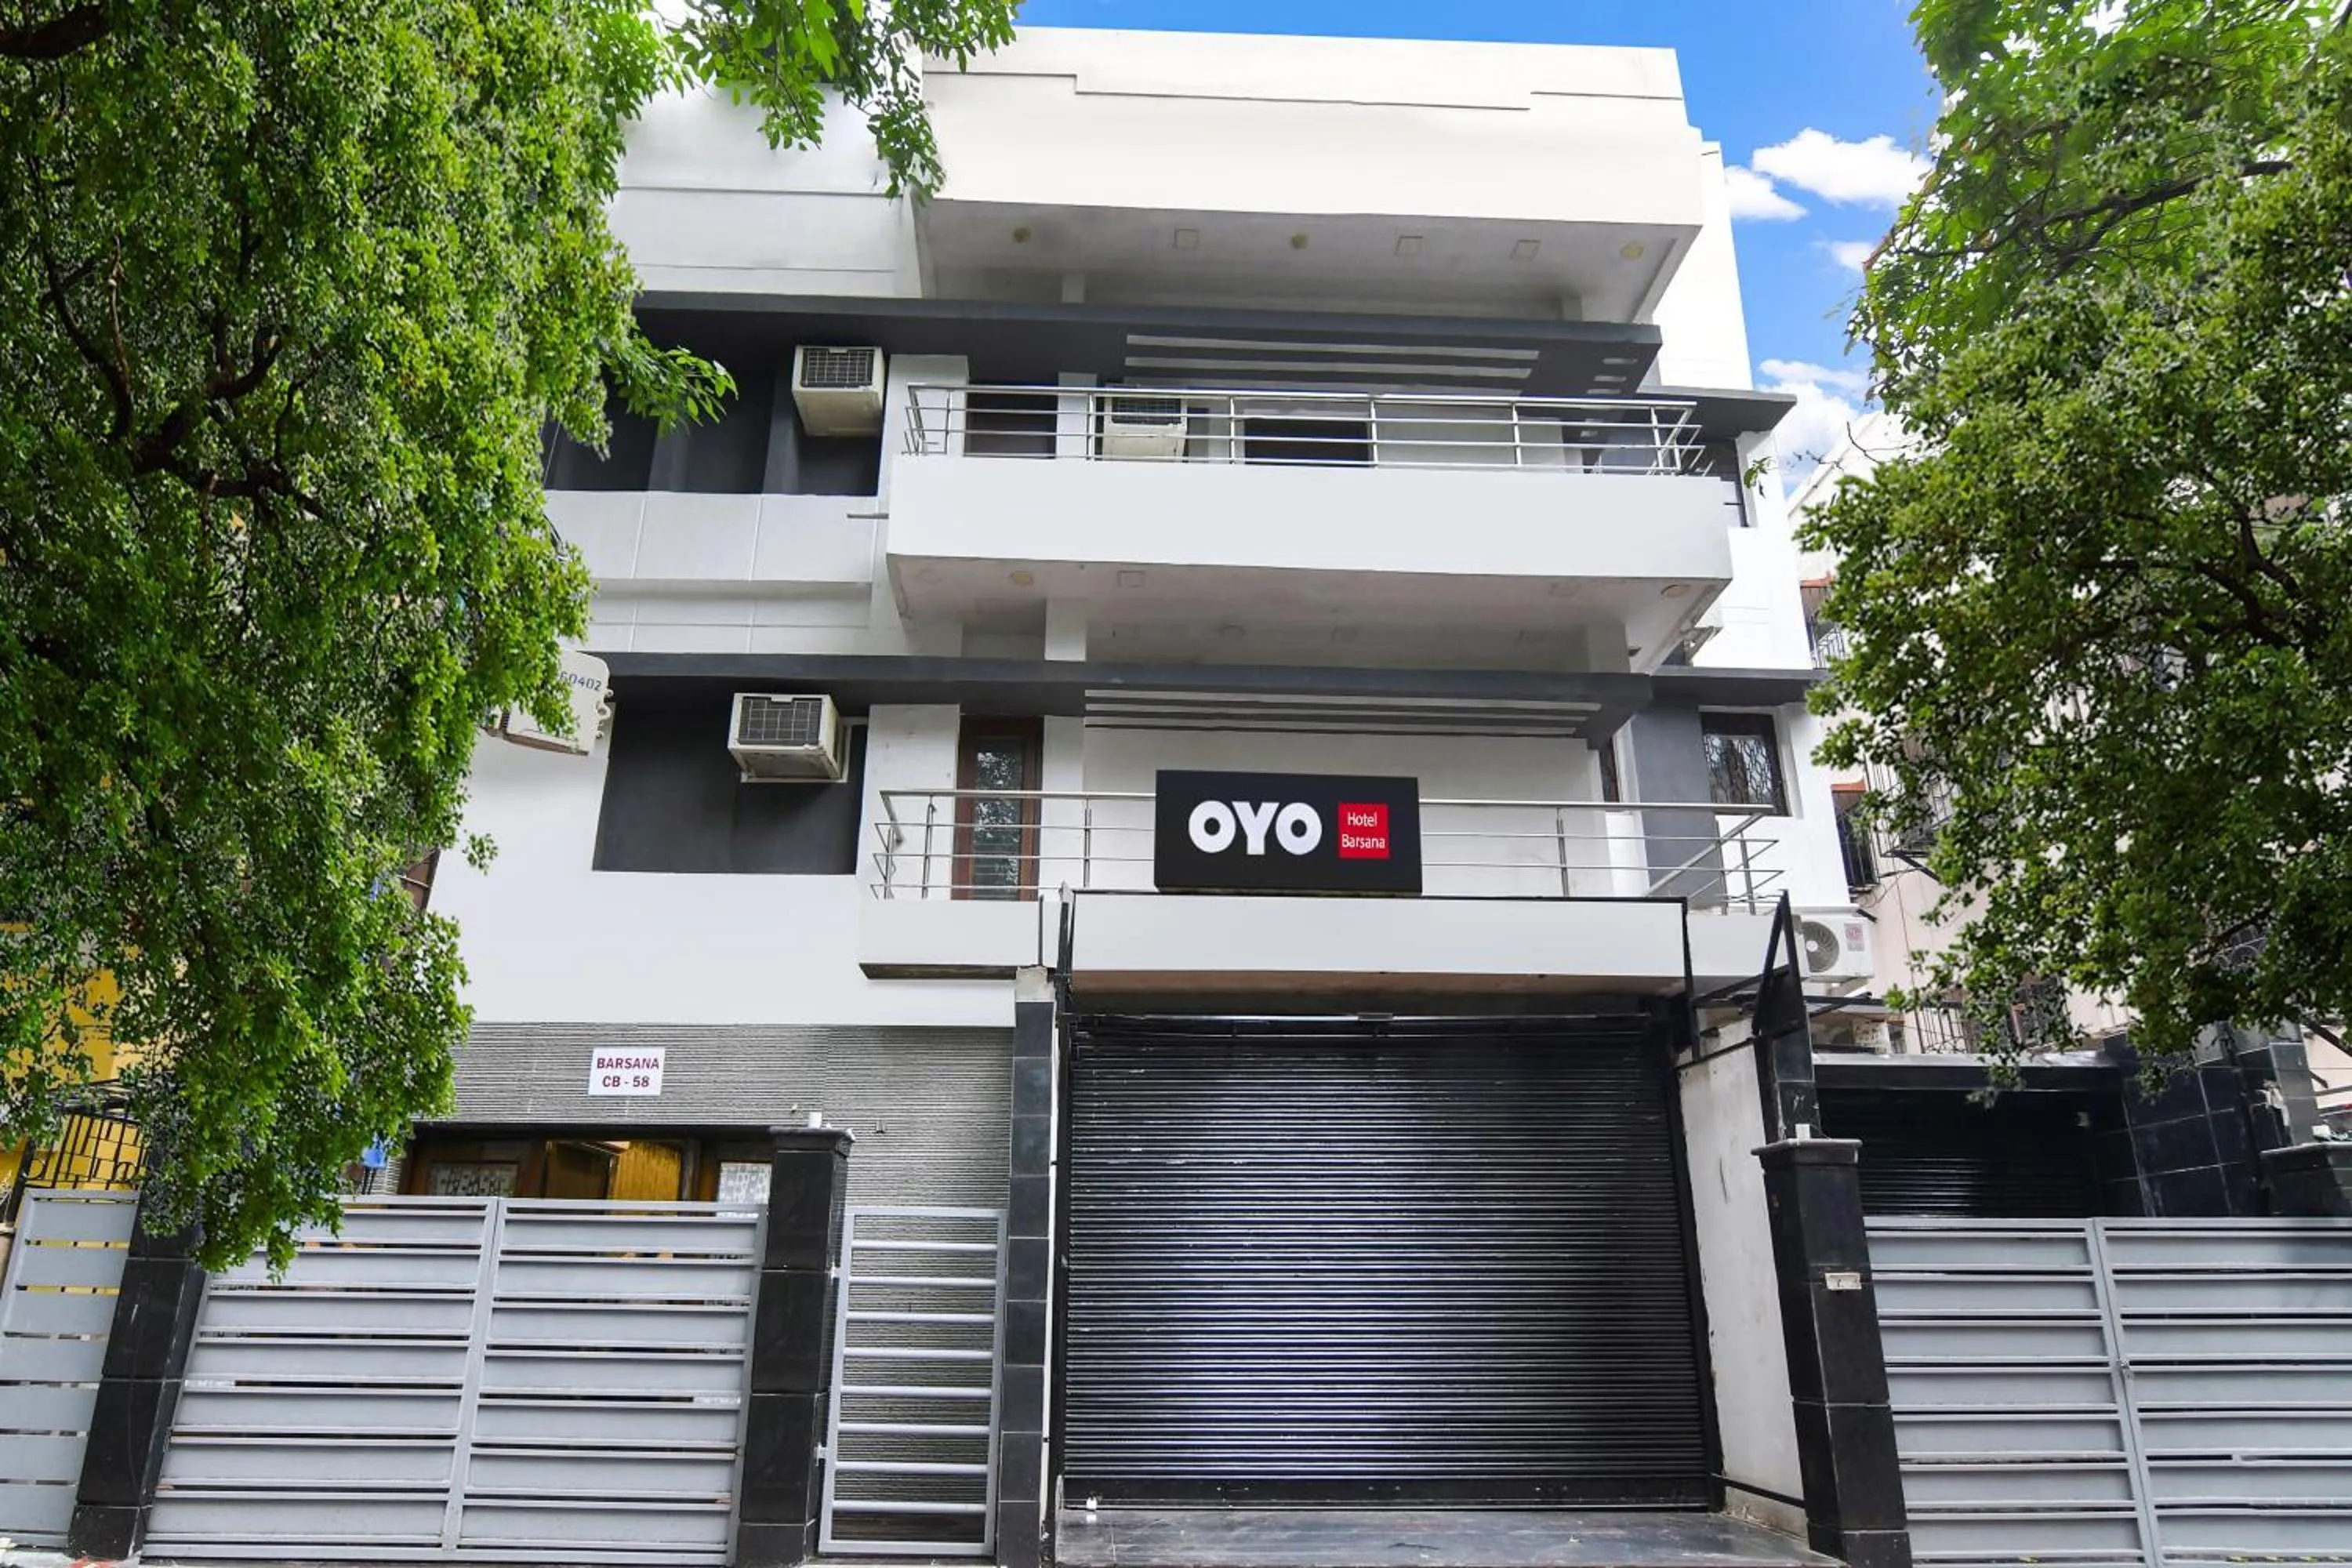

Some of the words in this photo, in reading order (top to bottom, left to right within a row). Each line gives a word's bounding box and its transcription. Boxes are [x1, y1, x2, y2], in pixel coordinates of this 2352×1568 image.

[1348, 811, 1377, 827] Hotel
[1189, 800, 1323, 855] OYO
[1341, 833, 1385, 849] Barsana
[597, 1058, 659, 1069] BARSANA
[602, 1076, 621, 1087] CB
[633, 1076, 650, 1087] 58
